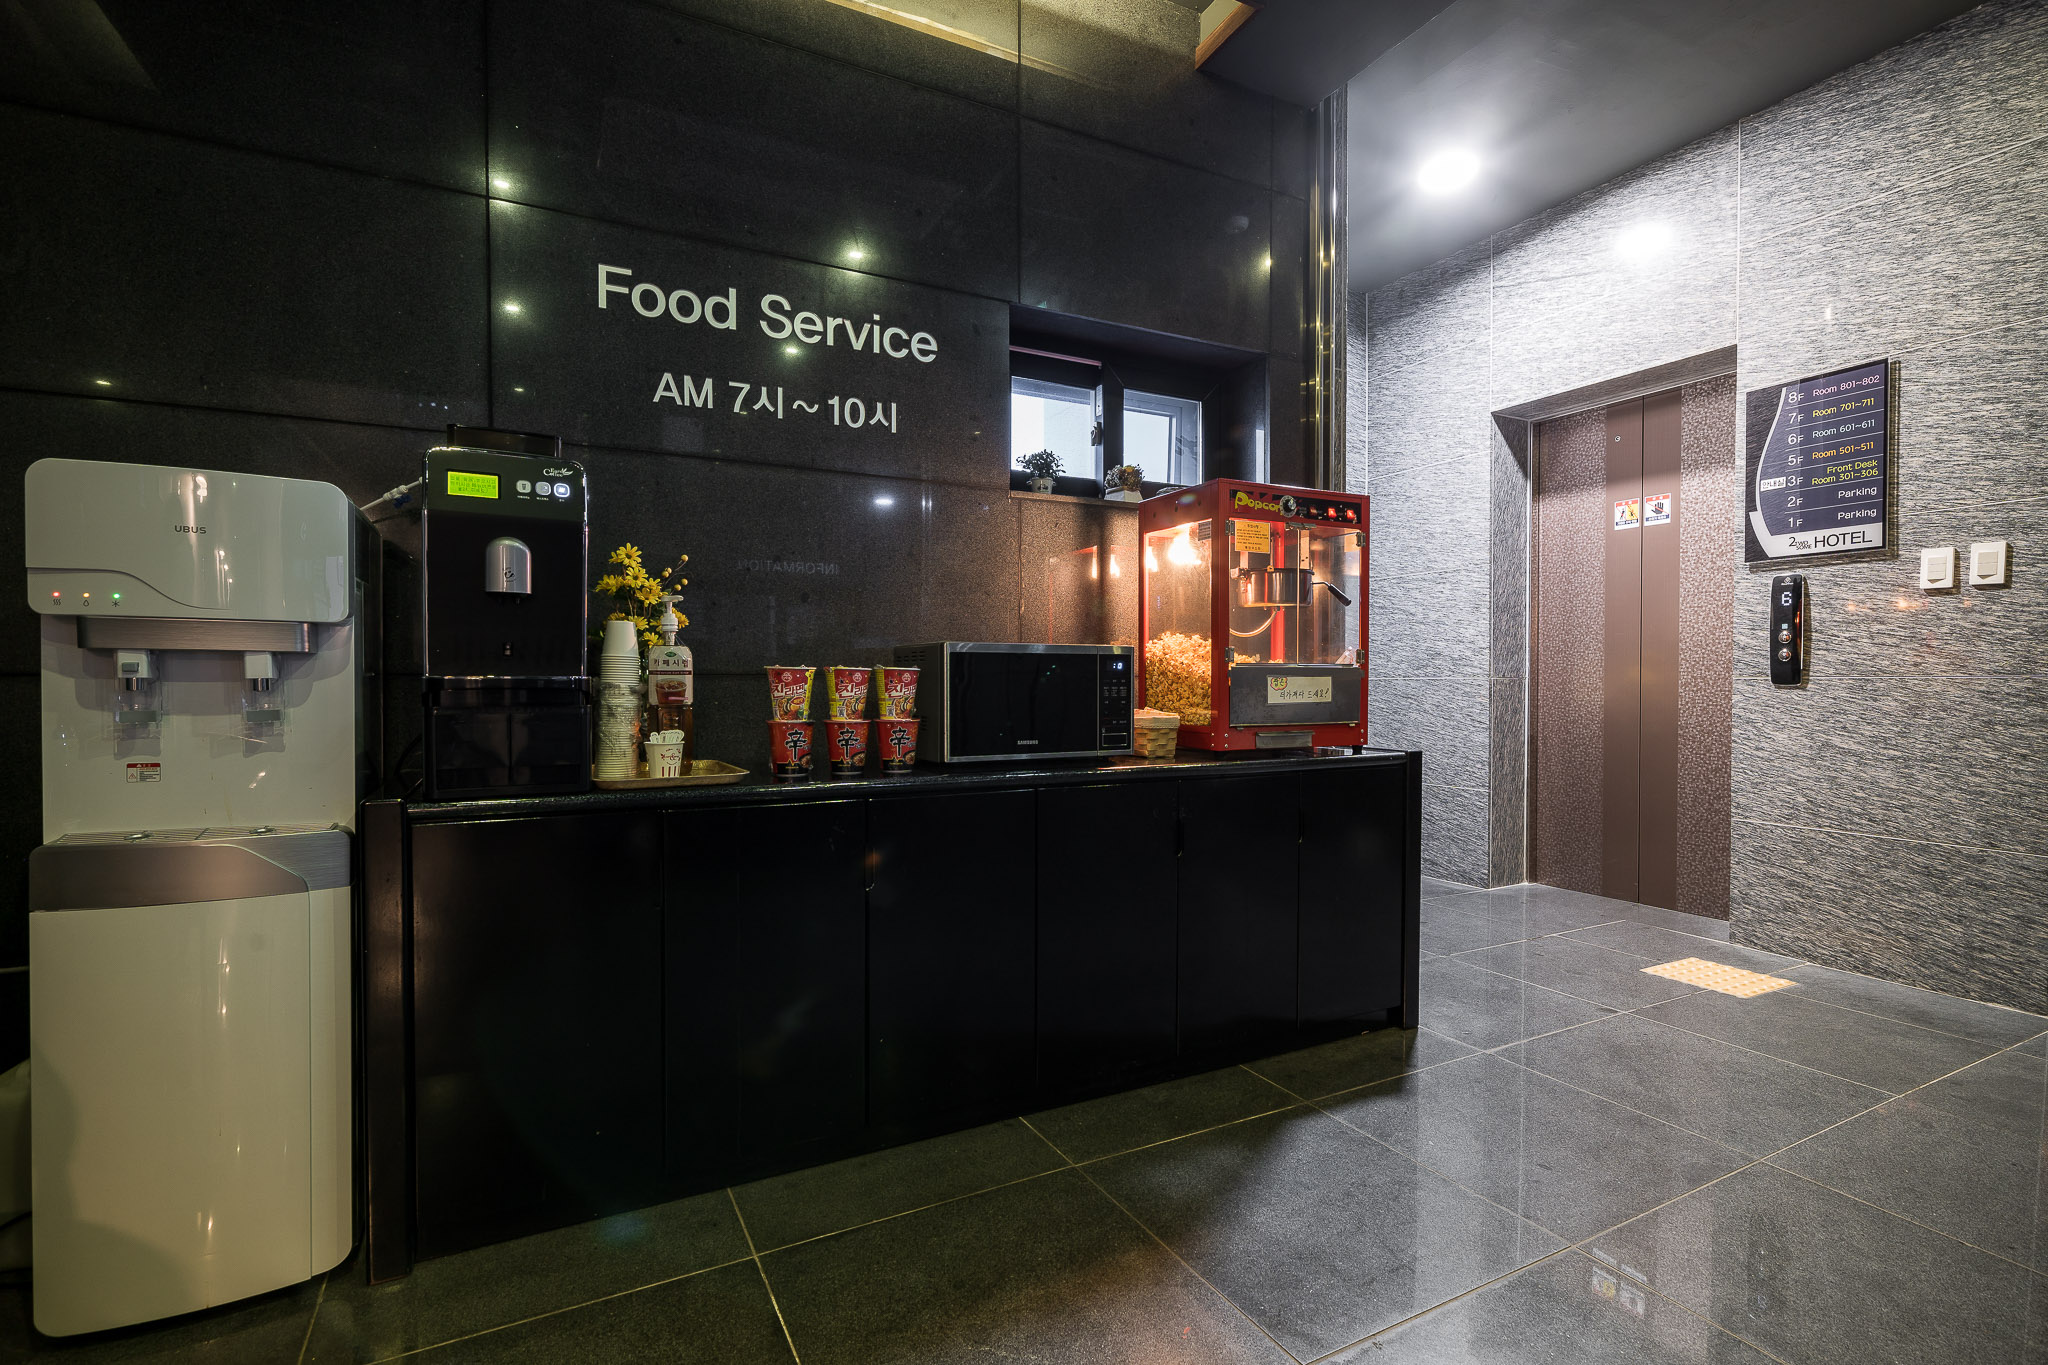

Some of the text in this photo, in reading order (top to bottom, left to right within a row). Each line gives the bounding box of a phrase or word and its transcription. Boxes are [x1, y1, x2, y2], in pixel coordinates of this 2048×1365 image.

[598, 263, 938, 363] Food Service
[653, 372, 713, 409] AM
[1813, 385, 1837, 397] Room
[1840, 375, 1880, 391] 801~802
[1812, 406, 1837, 418] Room
[1840, 397, 1874, 412] 701~711
[1812, 427, 1837, 439] Room
[1839, 419, 1875, 433] 601~611
[1812, 448, 1837, 460] Room
[1839, 441, 1874, 455] 501~511
[1811, 475, 1836, 485] Room
[1839, 468, 1878, 481] 301~306
[1827, 459, 1878, 474] Front Desk
[1838, 486, 1877, 499] Parking
[1234, 491, 1283, 516] Popcor
[1837, 508, 1877, 521] Parking
[174, 525, 207, 534] UBUS
[1814, 530, 1873, 549] HOTEL
[1781, 591, 1792, 606] 6
[785, 728, 808, 761] 辛
[837, 727, 860, 760] 辛
[889, 726, 912, 758] 辛
